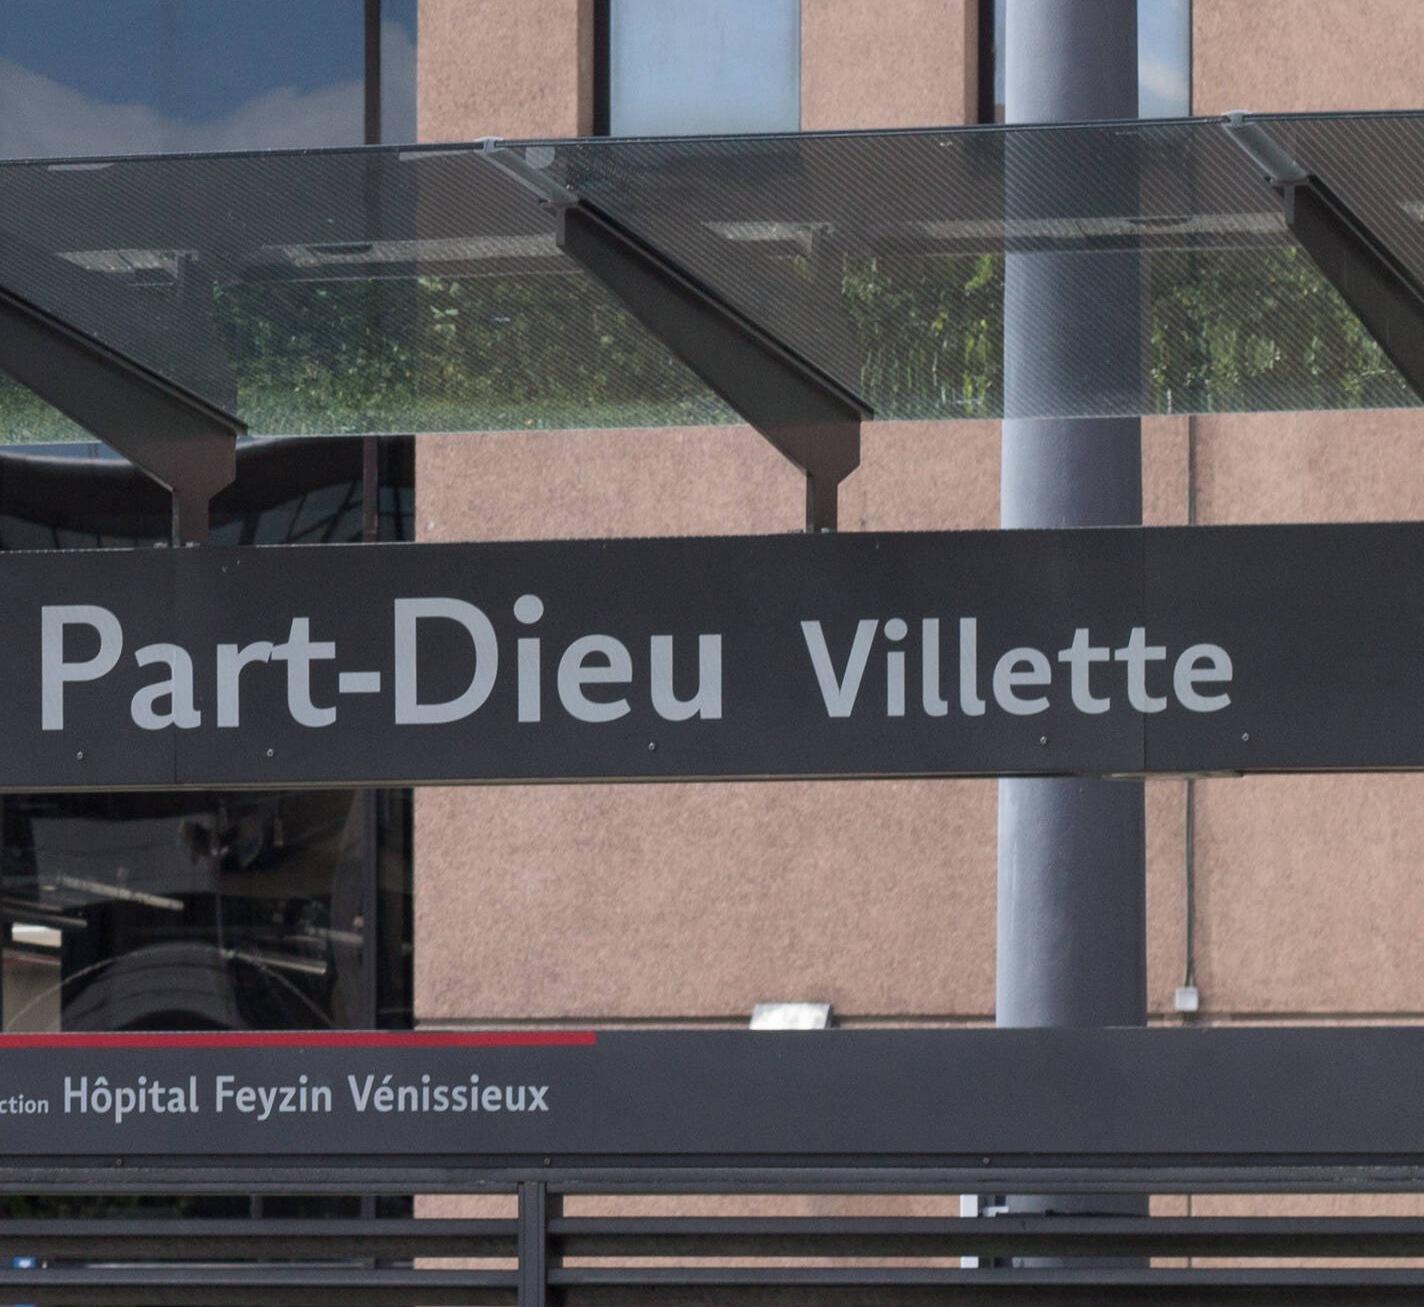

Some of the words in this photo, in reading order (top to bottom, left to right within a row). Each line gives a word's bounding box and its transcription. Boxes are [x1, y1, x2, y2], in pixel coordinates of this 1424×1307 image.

[40, 594, 723, 732] Part-Dieu
[799, 617, 1234, 719] Villette
[63, 1074, 200, 1124] Hôpital
[215, 1074, 333, 1122] Feyzin
[347, 1072, 550, 1113] Vénissieux
